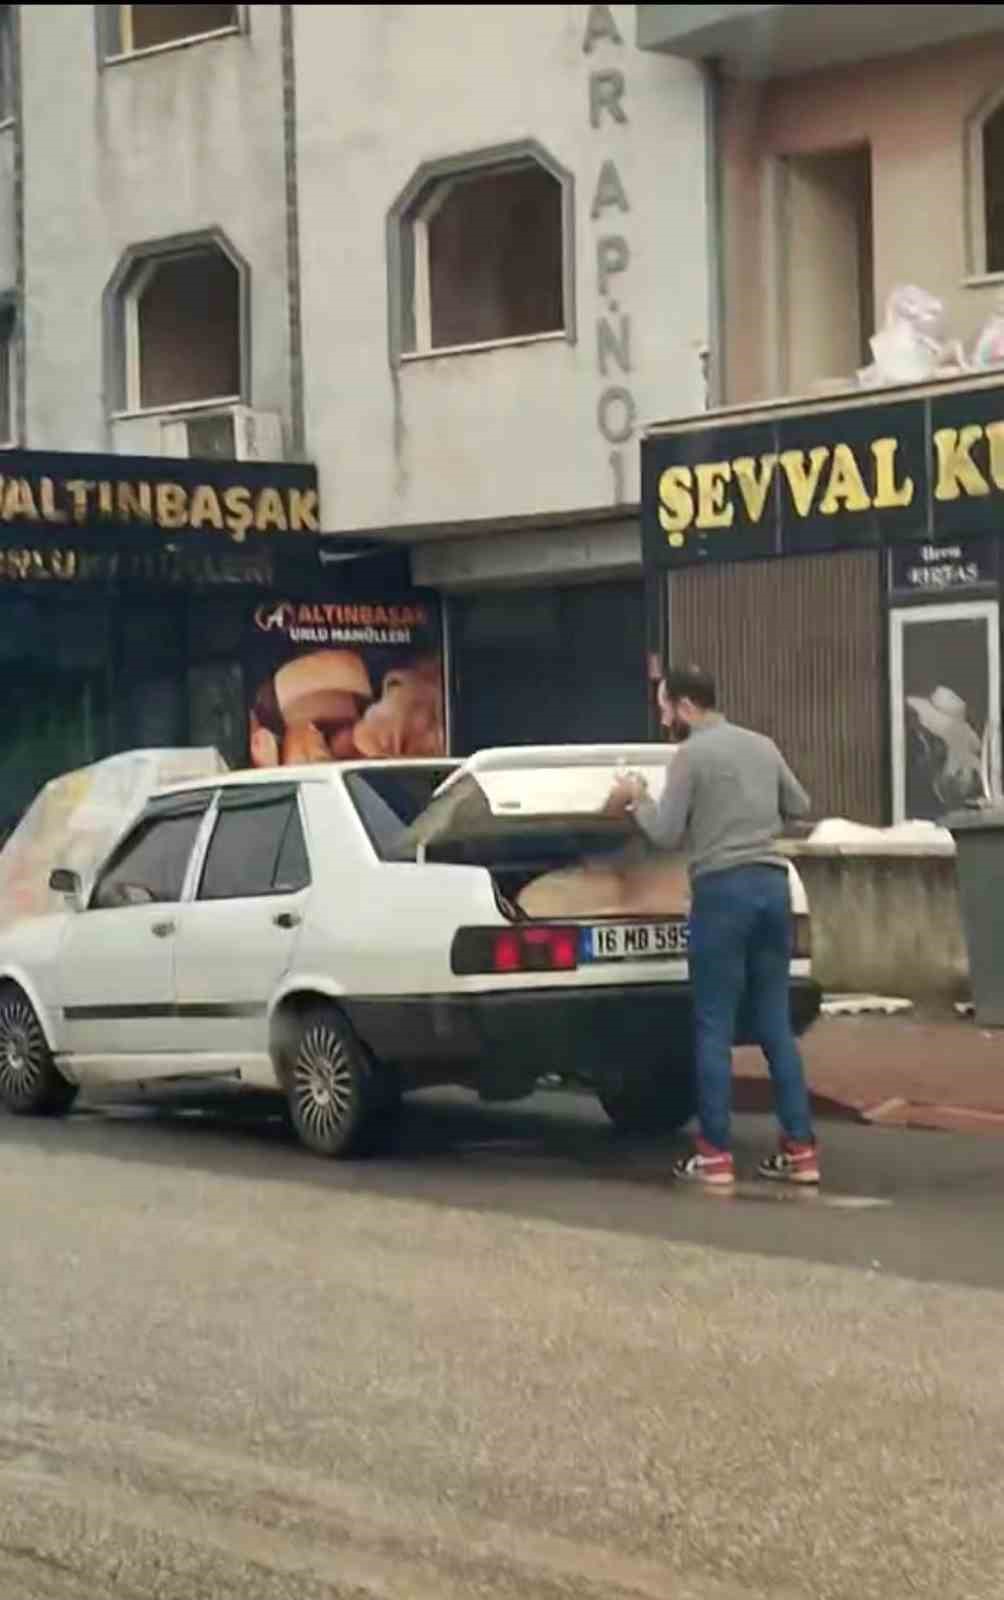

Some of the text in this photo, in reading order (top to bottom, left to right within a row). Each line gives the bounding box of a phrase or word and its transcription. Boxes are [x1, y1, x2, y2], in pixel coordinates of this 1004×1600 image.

[1, 474, 320, 543] ALTINBAŞAK
[658, 436, 914, 547] ŞEVVAL
[598, 929, 617, 952] 16
